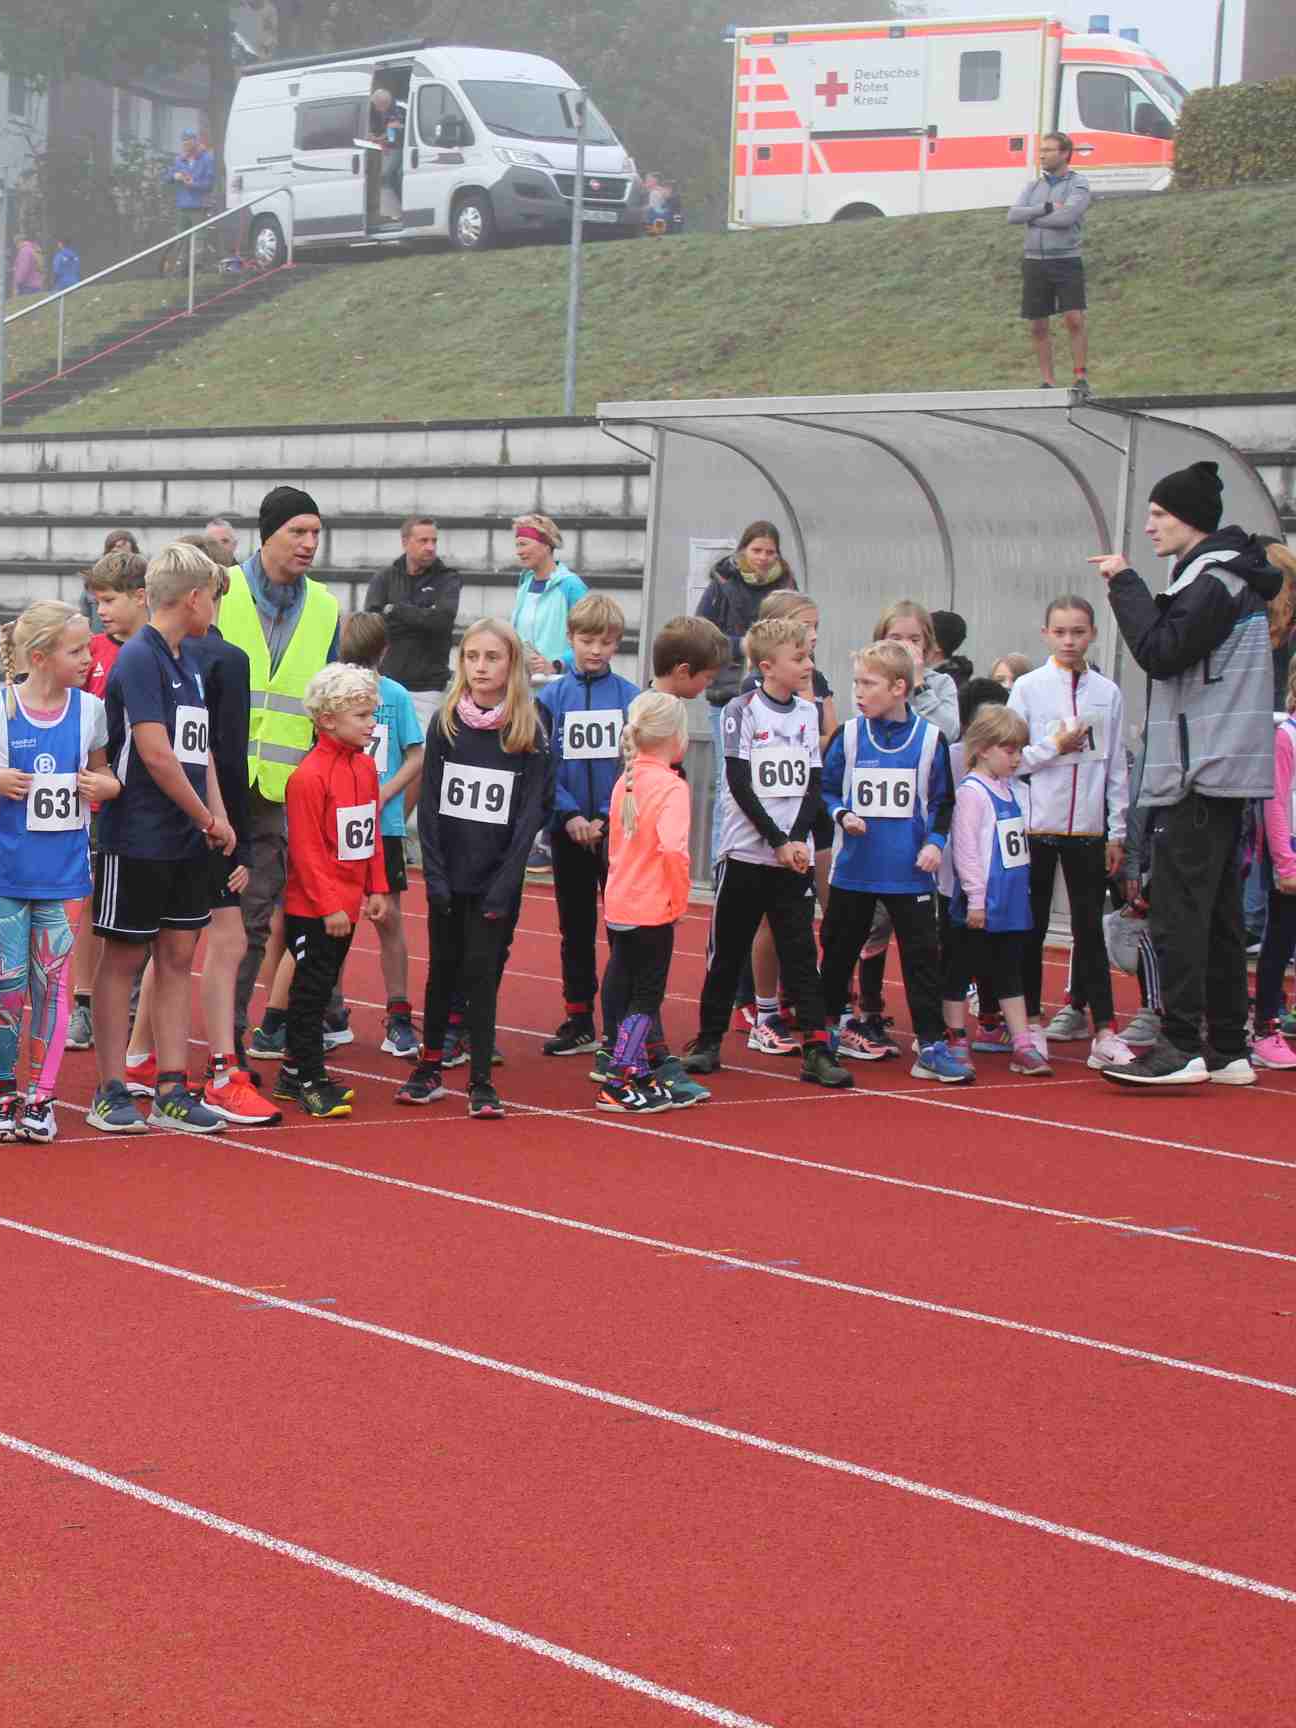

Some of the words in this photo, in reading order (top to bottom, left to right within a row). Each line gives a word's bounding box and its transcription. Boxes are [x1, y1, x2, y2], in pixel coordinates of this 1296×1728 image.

[855, 68, 920, 80] Deutsches
[854, 82, 889, 93] Rotes
[854, 96, 889, 105] Kreuz
[569, 722, 616, 749] 601
[759, 760, 806, 787] 603
[33, 787, 80, 819] 631
[447, 777, 505, 812] 619
[857, 781, 910, 807] 616
